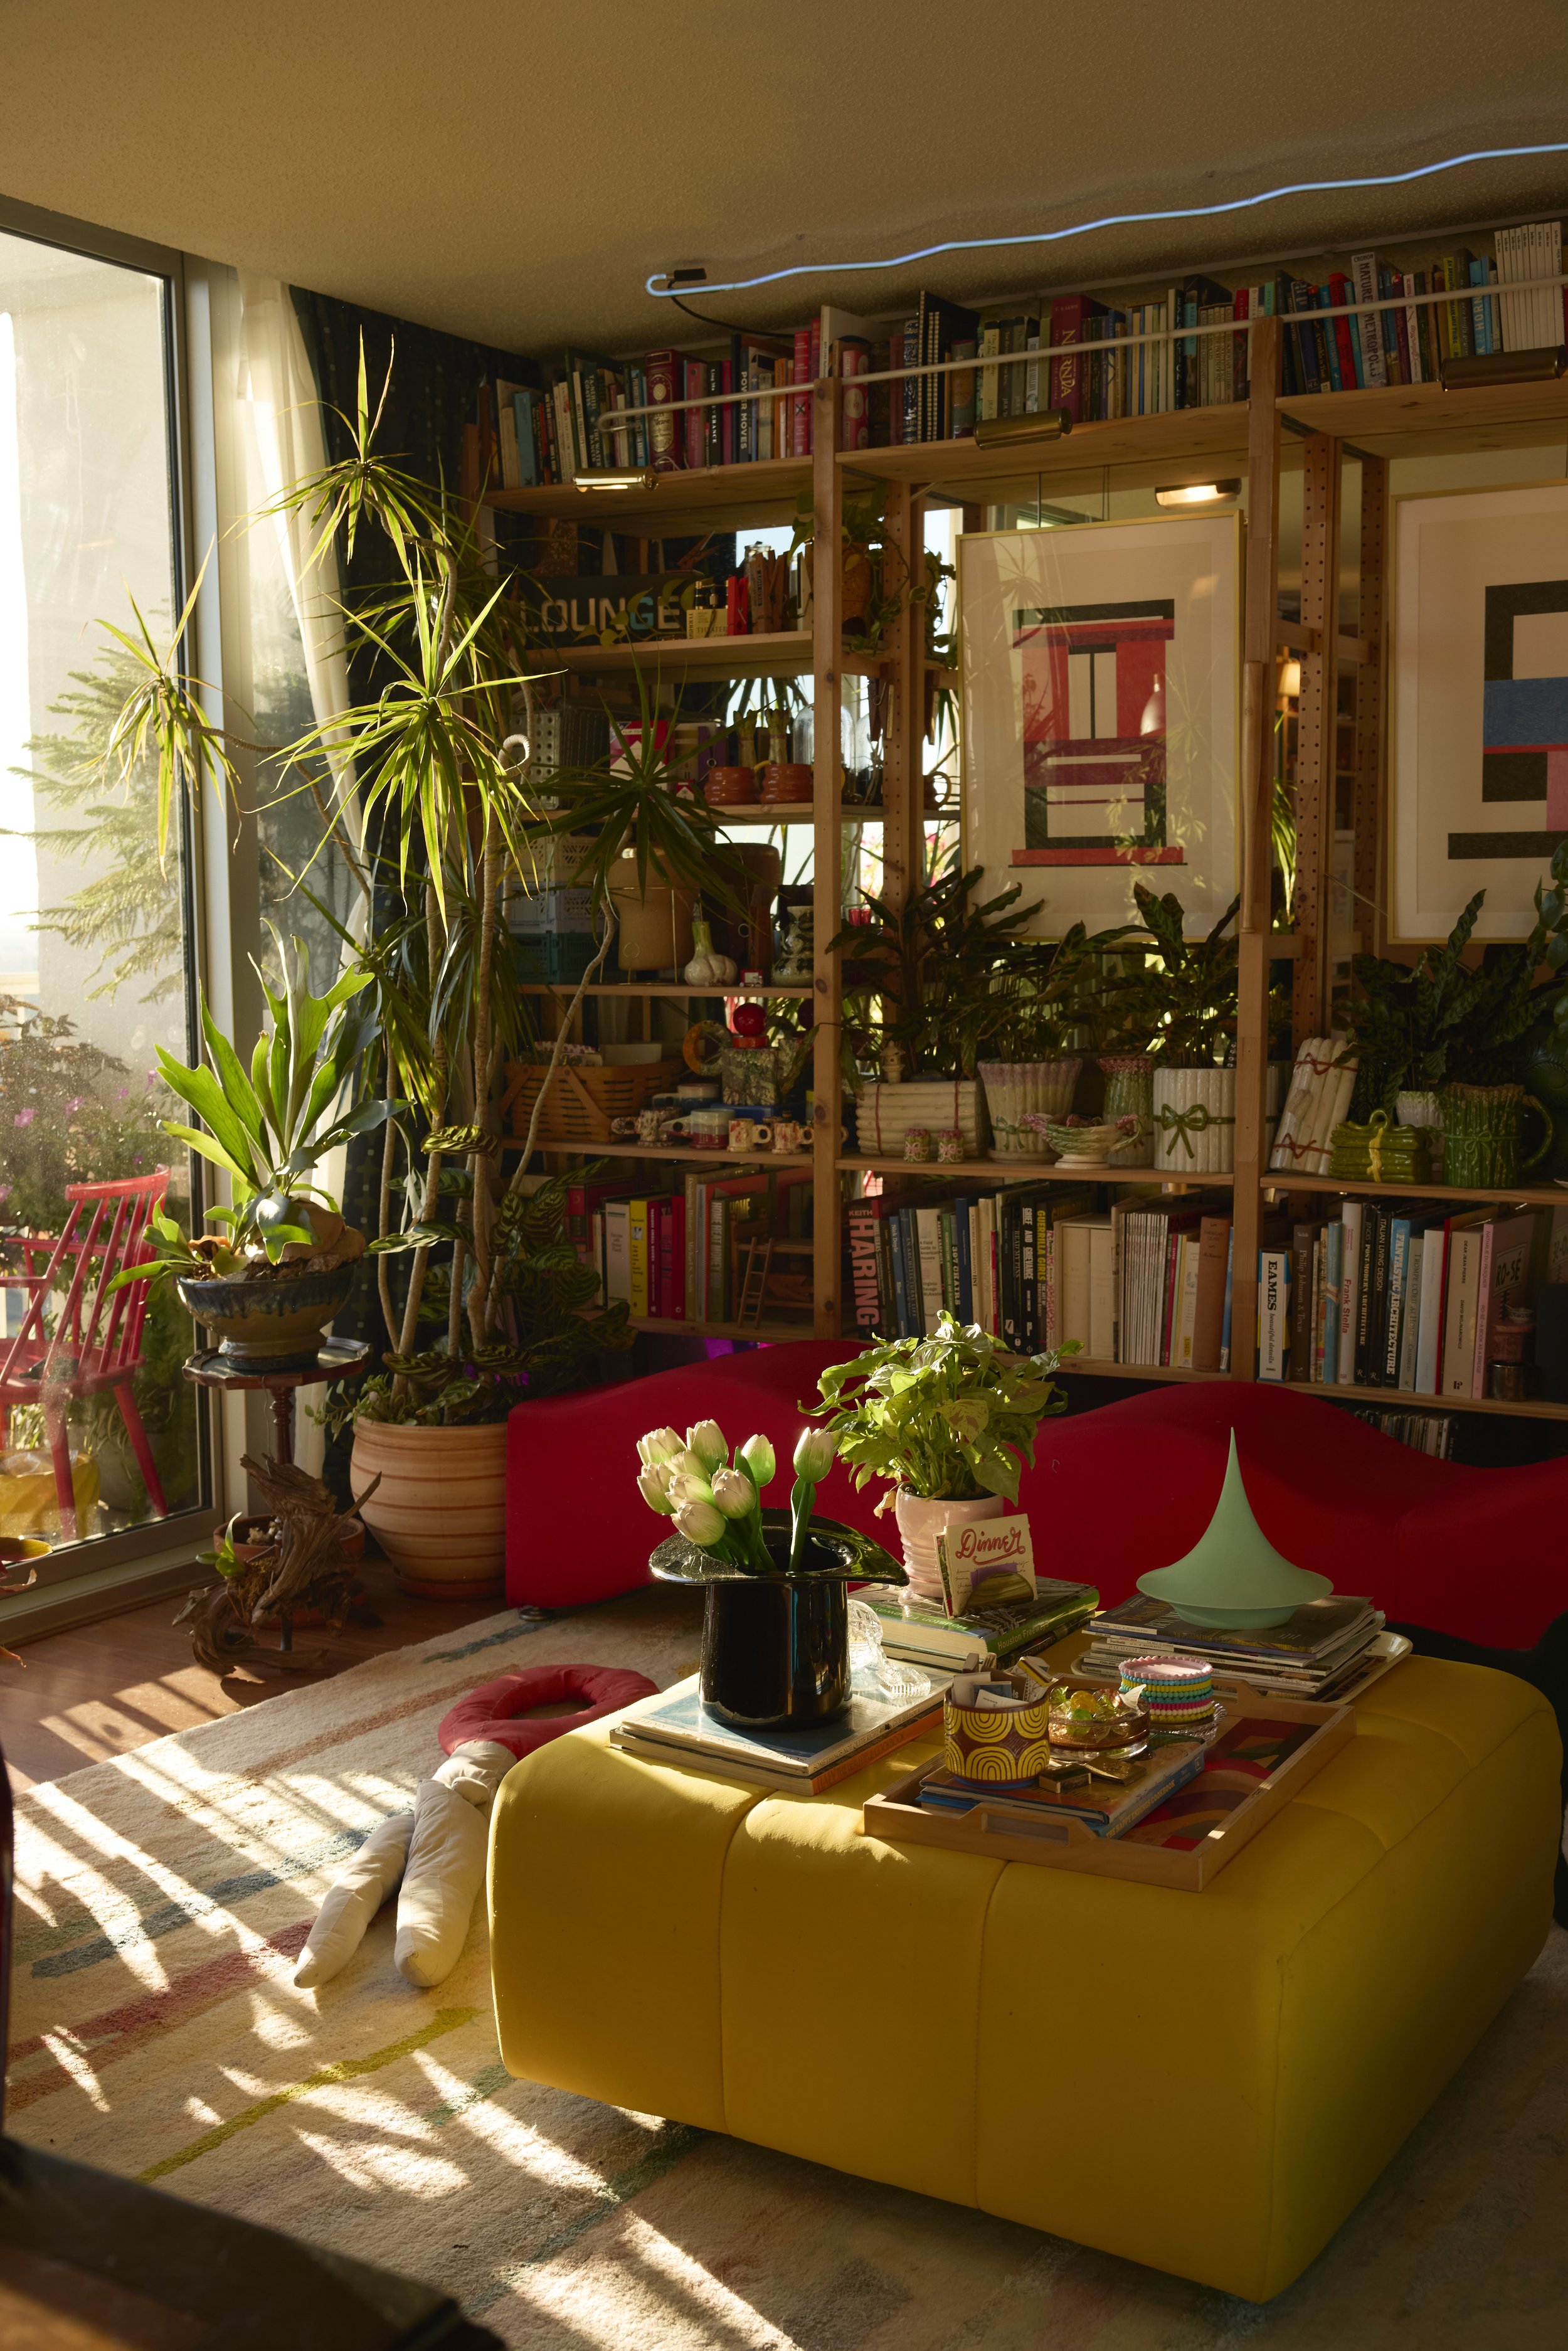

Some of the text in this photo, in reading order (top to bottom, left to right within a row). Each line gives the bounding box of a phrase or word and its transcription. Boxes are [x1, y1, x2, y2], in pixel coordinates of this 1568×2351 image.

[1353, 254, 1374, 263] CRONON
[1359, 262, 1380, 378] NATURE METROPOLIS
[1471, 281, 1485, 331] HORNY
[1060, 329, 1076, 398] NRNIA
[740, 371, 748, 450] POWR MOVES
[589, 435, 597, 462] DANCER
[520, 597, 680, 633] LOUNGE
[711, 1202, 723, 1224] HOME
[1024, 1207, 1033, 1225] GRIEF
[711, 1225, 723, 1244] HEAT
[906, 1237, 911, 1246] AN
[1025, 1230, 1033, 1243] AND
[1037, 1210, 1046, 1281] GUERRILLA GIRLS
[711, 1244, 723, 1271] MONEY
[849, 1218, 880, 1325] HARING
[1014, 1251, 1020, 1261] MY
[1024, 1247, 1034, 1280] GRIEVANCE
[1297, 1250, 1308, 1271] Philip
[1362, 1244, 1370, 1292] POST-MODERN
[1412, 1253, 1421, 1282] TROMPE
[1496, 1250, 1523, 1289] RO-SÉ
[907, 1247, 916, 1299] ARCHITECTURAL
[1268, 1260, 1278, 1310] EAMES
[1296, 1273, 1306, 1303] Johnson
[1342, 1279, 1352, 1334] Frank Stella
[1386, 1233, 1406, 1374] FANTASTIC ARCHITECTURE
[1410, 1306, 1416, 1315] AT
[1296, 1313, 1305, 1333] Texas
[1360, 1294, 1368, 1346] ARCHITECTURE
[1408, 1316, 1416, 1337] HOME
[955, 1527, 1025, 1562] Dinner
[921, 1615, 967, 1631] Houston
[997, 1621, 1050, 1650] Houston Freeways
[814, 1750, 844, 1770] SOMETHINGS
[843, 1744, 854, 1756] NOT
[854, 1738, 866, 1749] QUITE
[892, 1717, 901, 1727] GUY
[875, 1733, 904, 1756] COOKBOOK
[1106, 1780, 1175, 1838] THE HAPPY ENDINGS COOKBOOK
